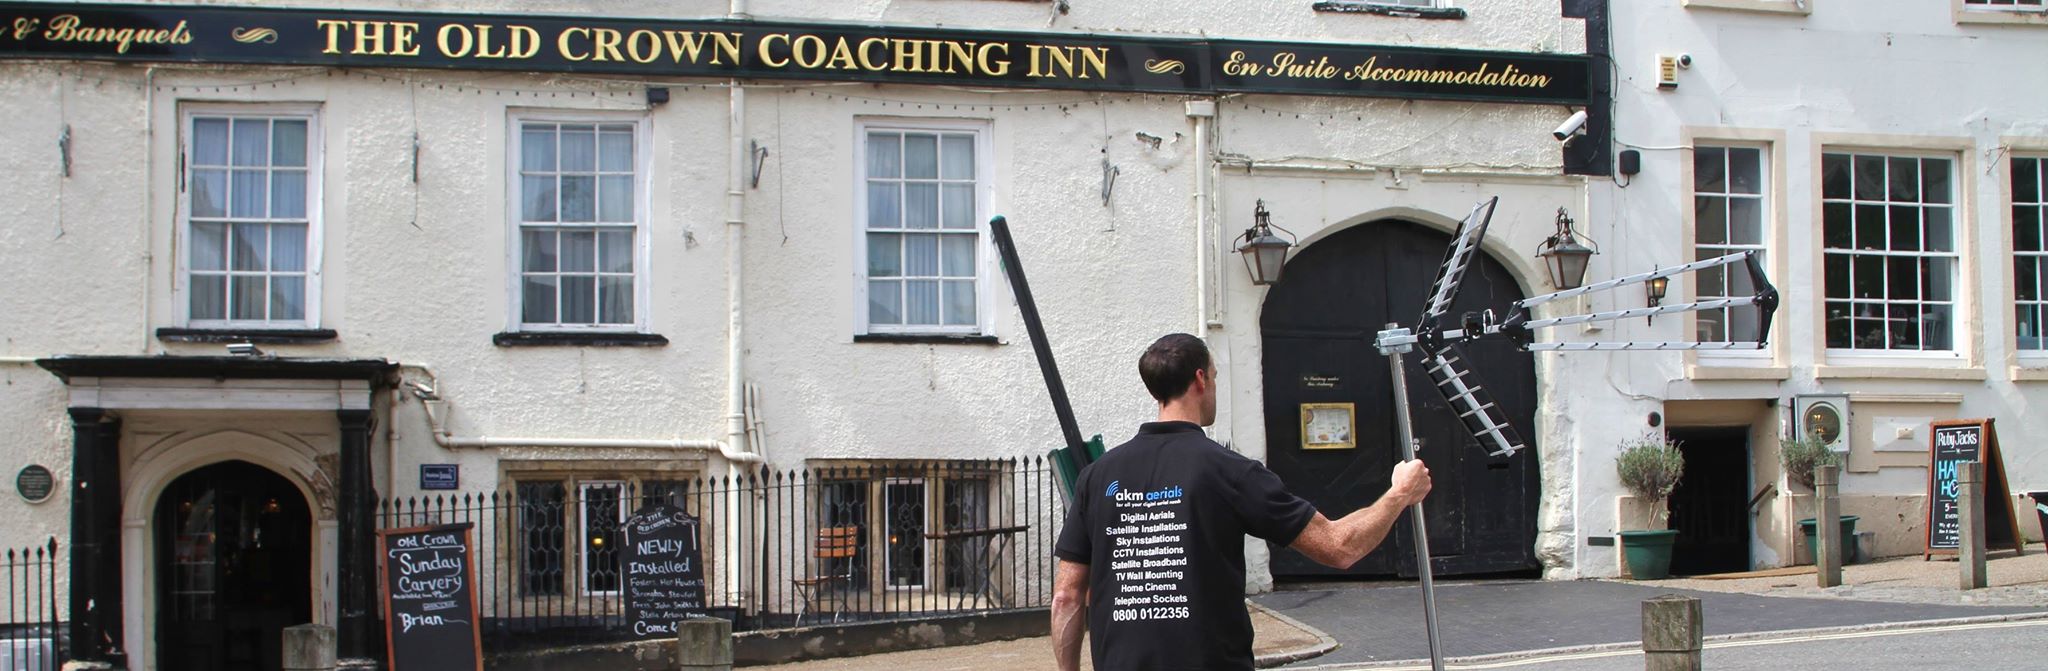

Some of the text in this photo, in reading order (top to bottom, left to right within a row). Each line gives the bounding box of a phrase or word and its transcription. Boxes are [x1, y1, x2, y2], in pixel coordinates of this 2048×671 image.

[14, 14, 194, 54] & Banquets
[317, 19, 1110, 80] THE OLD CROWN COACHING INN
[1223, 50, 1552, 88] En Suite Accommodation
[1937, 430, 1978, 448] Ruby Jacks
[1115, 485, 1183, 501] akm aerials
[646, 512, 662, 522] THE
[1120, 511, 1175, 523] Digital Aerials
[1106, 522, 1187, 536] Satellite Installations
[422, 534, 457, 546] Crown
[1116, 534, 1180, 547] Sky Installations
[637, 539, 683, 558] NEWLY
[1113, 546, 1184, 558] CCTV Installations
[400, 551, 462, 577] Sunday
[629, 557, 690, 574] Installed
[1111, 557, 1187, 570] Satellite Broadband
[1116, 570, 1183, 581] TV Wall Mounting
[399, 576, 462, 596] Carvery
[1121, 583, 1177, 593] Home Cinema
[1114, 594, 1188, 607] Telephone Sockets
[1113, 607, 1190, 621] 0800 0122356
[398, 613, 443, 633] Brian
[634, 620, 669, 636] Come
